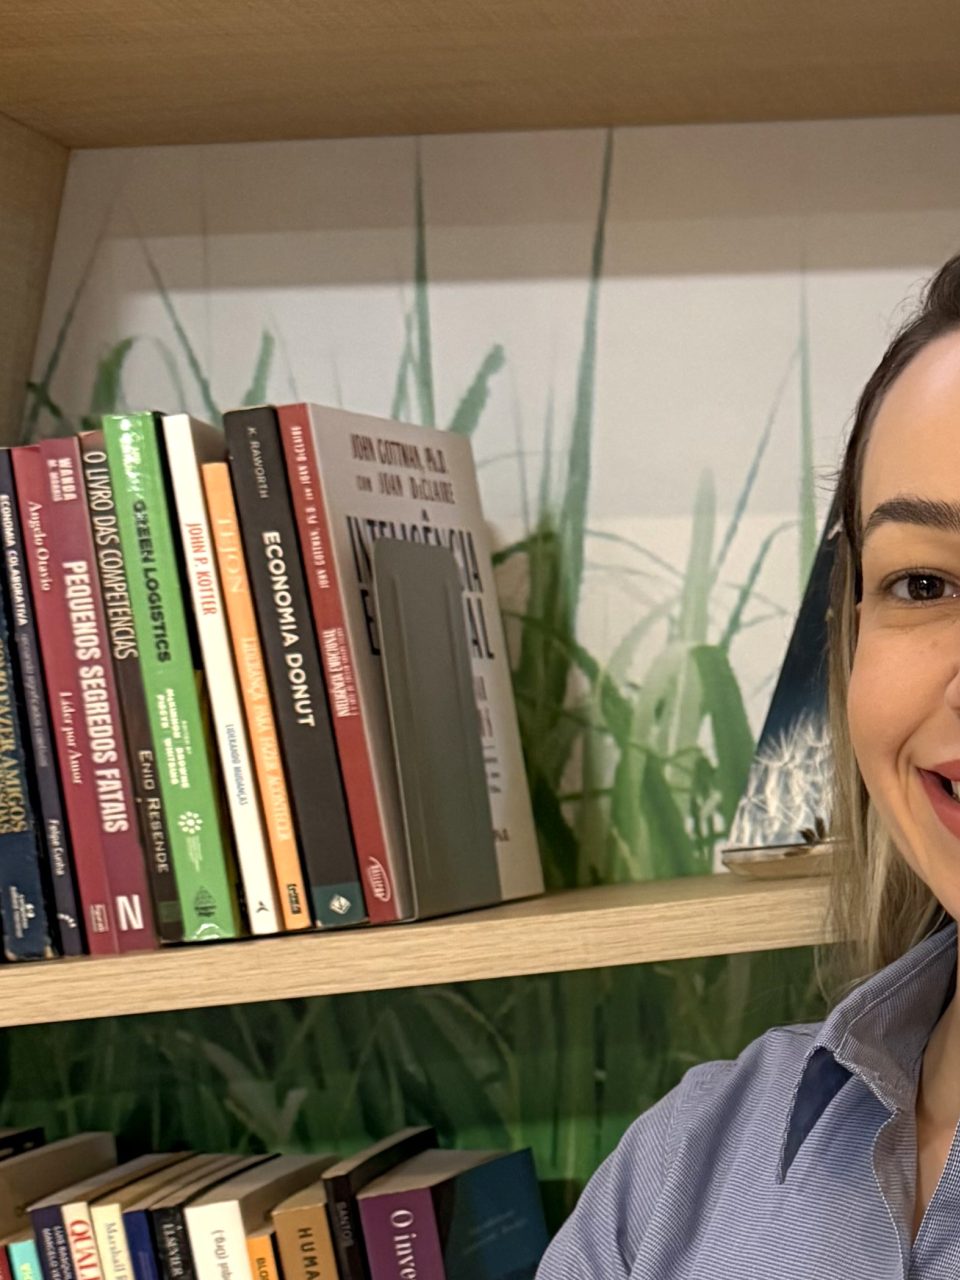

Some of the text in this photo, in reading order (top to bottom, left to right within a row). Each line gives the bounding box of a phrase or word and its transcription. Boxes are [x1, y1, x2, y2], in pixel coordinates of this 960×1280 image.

[83, 451, 107, 464] O
[250, 440, 269, 499] RAWORTH
[351, 434, 377, 462] JOHN
[58, 457, 77, 501] WANDA
[86, 468, 114, 511] LIVRO
[378, 472, 404, 496] JOAN
[92, 516, 120, 545] DAS
[133, 500, 155, 563] GREEN
[1, 494, 28, 626] ECONOMIA COLABORATIVA
[185, 523, 205, 553] JOHN
[196, 571, 217, 615] KOTTER
[141, 567, 171, 663] LOGISTICS
[262, 531, 315, 727] ECONOMIA DONUT
[62, 560, 129, 832] PEQUENOS SEGREDOS FATAIS
[61, 727, 75, 747] por
[68, 747, 82, 784] Amor
[0, 752, 28, 832] AMIGOS
[49, 819, 64, 875] Felipe Cunha
[146, 798, 169, 873] RESENDE
[106, 1222, 126, 1272] Marshall
[390, 1209, 413, 1228] O
